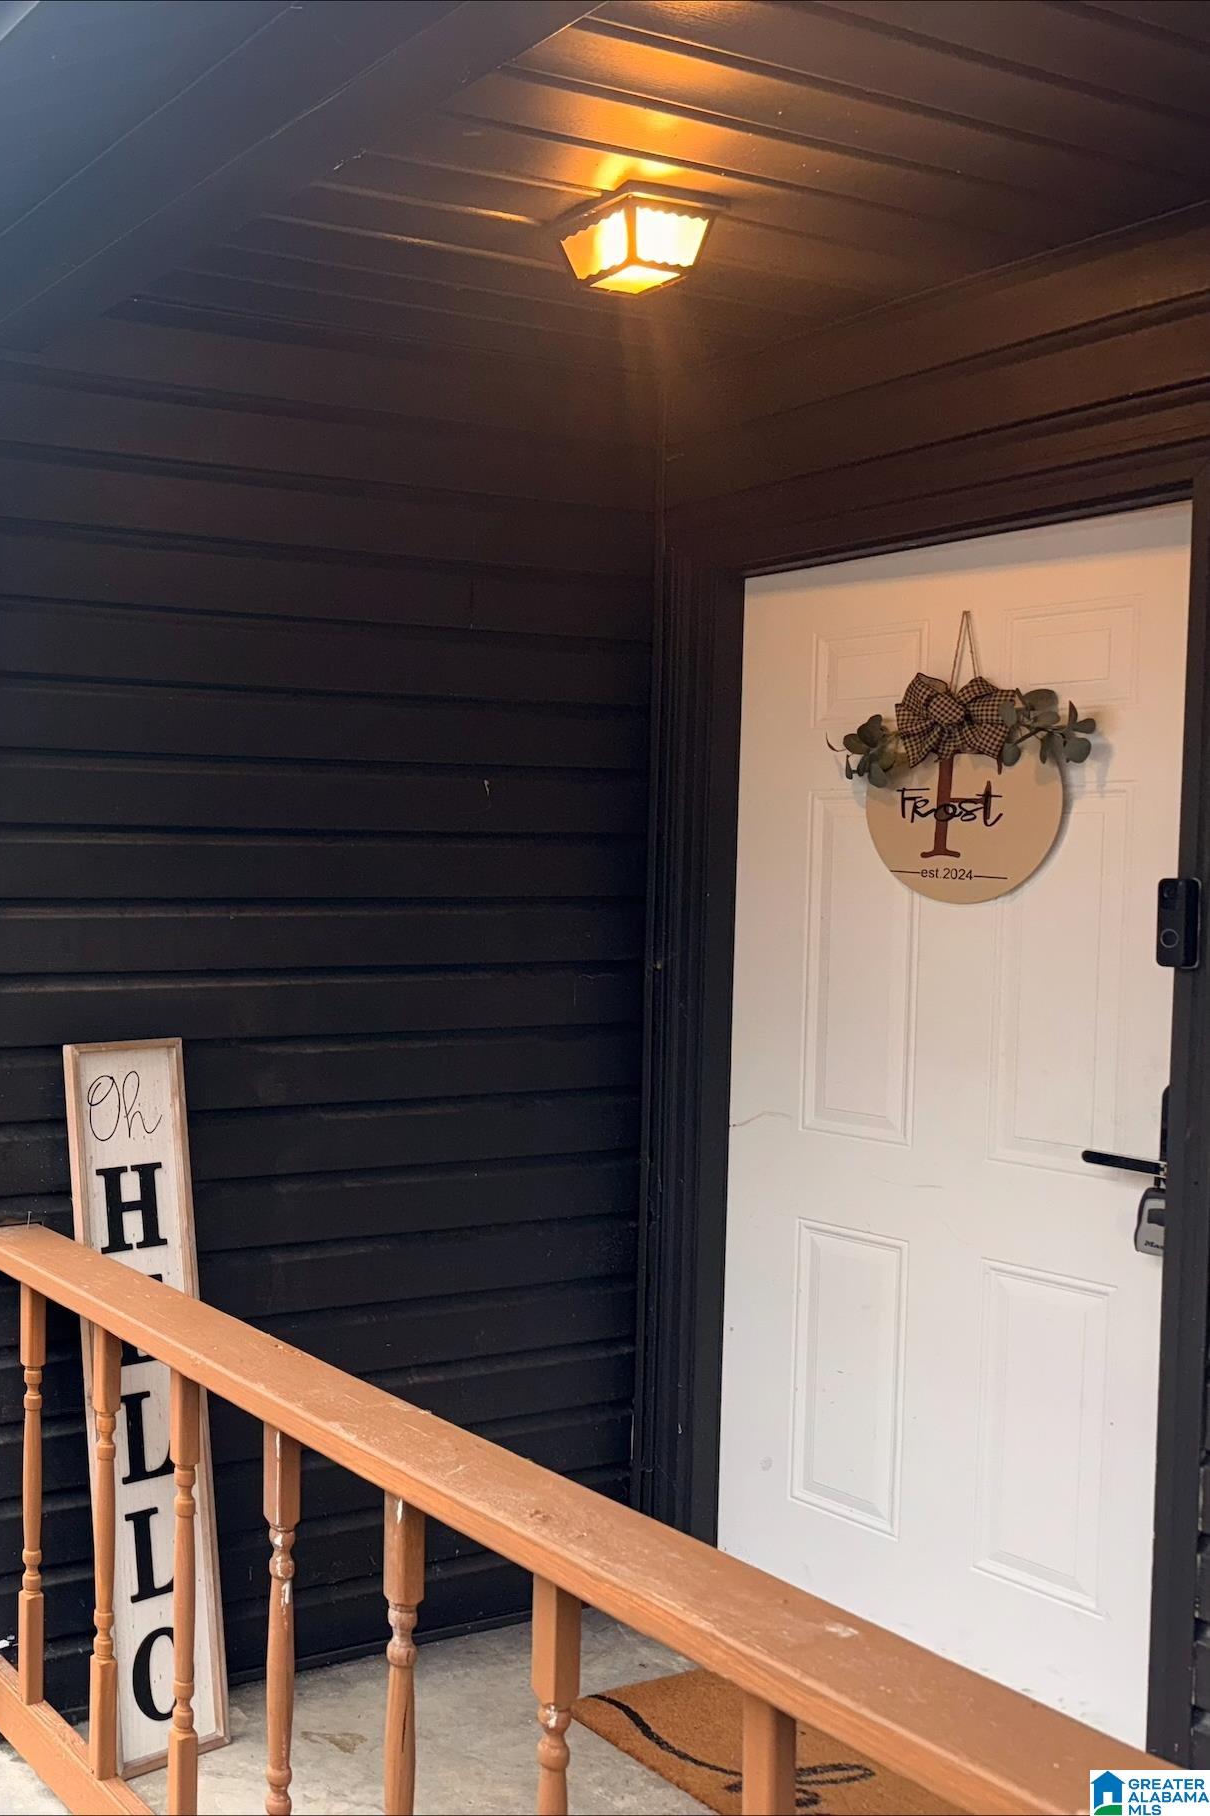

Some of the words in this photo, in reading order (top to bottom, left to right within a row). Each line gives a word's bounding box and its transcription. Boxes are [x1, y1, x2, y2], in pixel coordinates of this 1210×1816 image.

[896, 787, 1003, 827] Frost
[87, 1070, 163, 1142] Oh
[95, 1161, 178, 1722] HLLO
